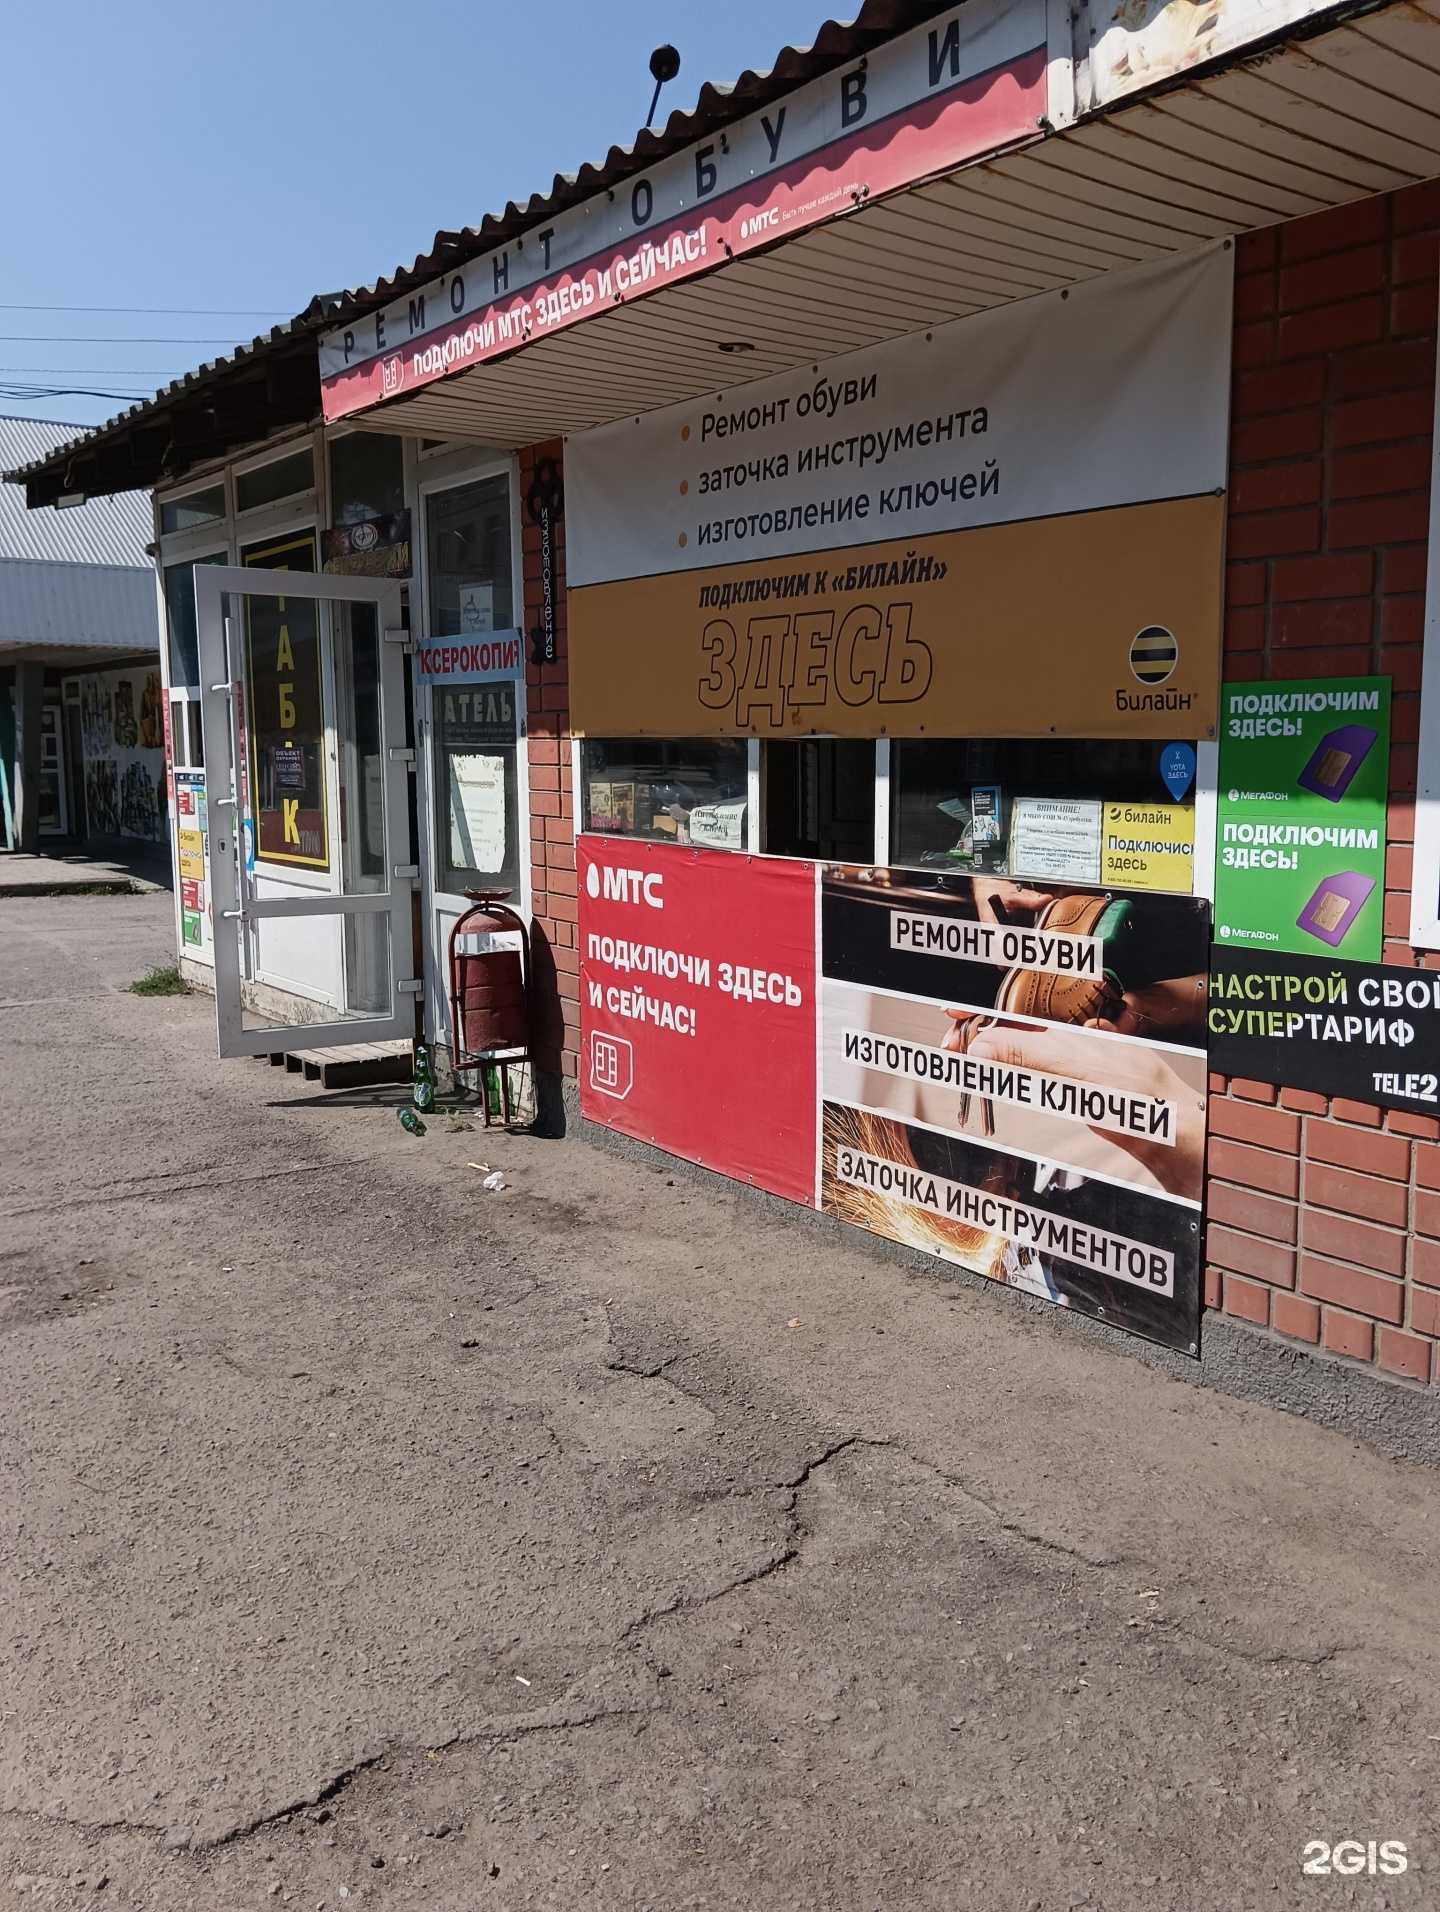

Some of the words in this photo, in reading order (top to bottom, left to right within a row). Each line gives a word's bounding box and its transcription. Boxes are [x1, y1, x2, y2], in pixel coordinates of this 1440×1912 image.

[343, 228, 554, 364] РЕМОНТ
[631, 20, 961, 226] ОБУВИ
[749, 208, 780, 235] МТС
[413, 320, 495, 377] ПОДКЛЮЧИ
[498, 304, 533, 340] МТС
[535, 275, 594, 327] ЗДЕСЬ
[597, 269, 612, 298] И
[615, 225, 707, 291] СЕЙЧАС!
[701, 398, 790, 442] Ремонт
[796, 373, 878, 418] обуви
[698, 453, 789, 495] заточка
[797, 406, 989, 472] инструмента
[698, 493, 871, 546] изготовление
[878, 458, 1000, 514] ключей
[698, 569, 810, 611] ПОДКЛЮЧИМ
[814, 569, 829, 594] К
[831, 552, 948, 592] «БИЛАЙН»
[698, 602, 933, 727] ЗДЕСЬ
[272, 564, 301, 845] ТАБК
[1228, 718, 1303, 739] ЗДЕСЬ!
[1229, 691, 1379, 715] ПОДКЛЮЧИМ
[1124, 807, 1172, 825] билайн
[1223, 823, 1379, 849] ПОДКЛЮЧИМ
[1107, 856, 1148, 872] здесь
[1222, 847, 1298, 870] ЗДЕСЬ!
[602, 866, 664, 909] МТС
[588, 933, 711, 988] ПОДКЛЮЧИ
[717, 962, 802, 1008] ЗДЕСЬ
[896, 917, 996, 960] РЕМОНТ
[1002, 932, 1096, 974] ОБУВИ
[588, 981, 603, 1009] И
[606, 985, 696, 1037] СЕЙЧАС!
[1209, 971, 1348, 1005] НАСТРОЙ
[1208, 1008, 1415, 1047] СУПЕРТАРИФ
[844, 1032, 1033, 1103] ИЗГОТОВЛЕНИЕ
[1040, 1079, 1171, 1139] КЛЮЧЕЙ
[1372, 1073, 1438, 1103] TELE2
[840, 1151, 938, 1209] ЗАТОЧКА
[945, 1188, 1169, 1287] ИНСТРУМЕНТОВ
